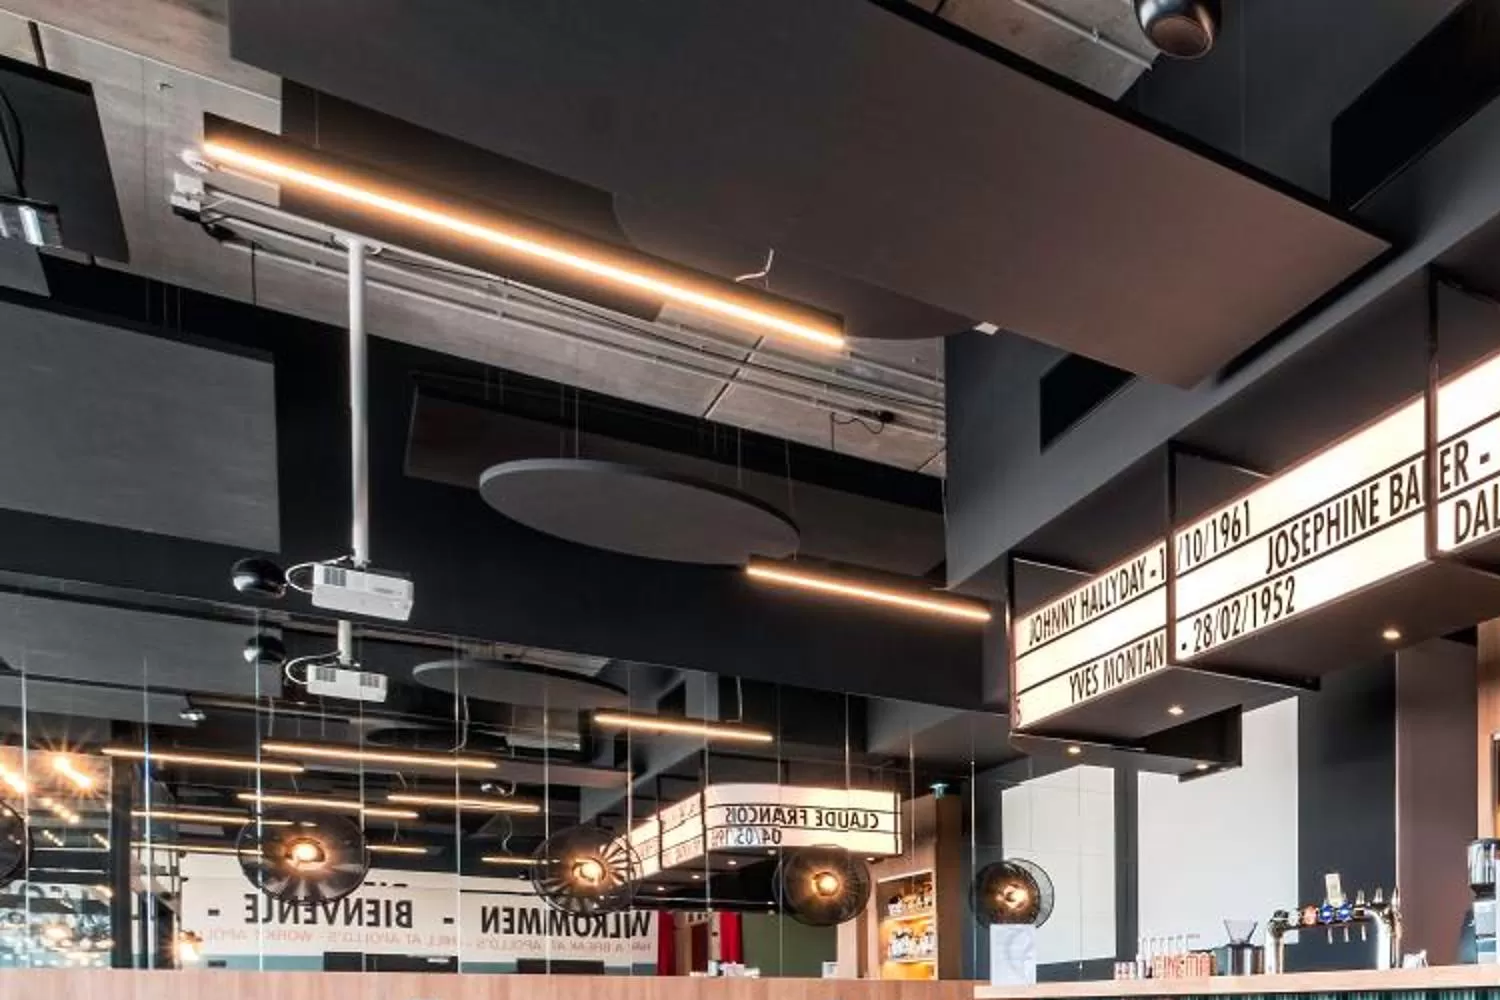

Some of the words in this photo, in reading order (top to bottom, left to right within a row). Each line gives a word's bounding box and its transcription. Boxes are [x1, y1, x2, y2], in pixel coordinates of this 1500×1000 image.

[1265, 487, 1380, 574] JOSEPHINE
[1389, 440, 1469, 517] BAER
[1480, 448, 1491, 464] -
[1029, 600, 1076, 647] JOHNNY
[1081, 561, 1145, 622] HALLYDAY
[1069, 667, 1099, 704] YVES
[1104, 633, 1165, 690] MONTAN
[1194, 575, 1296, 653] 28/02/1952
